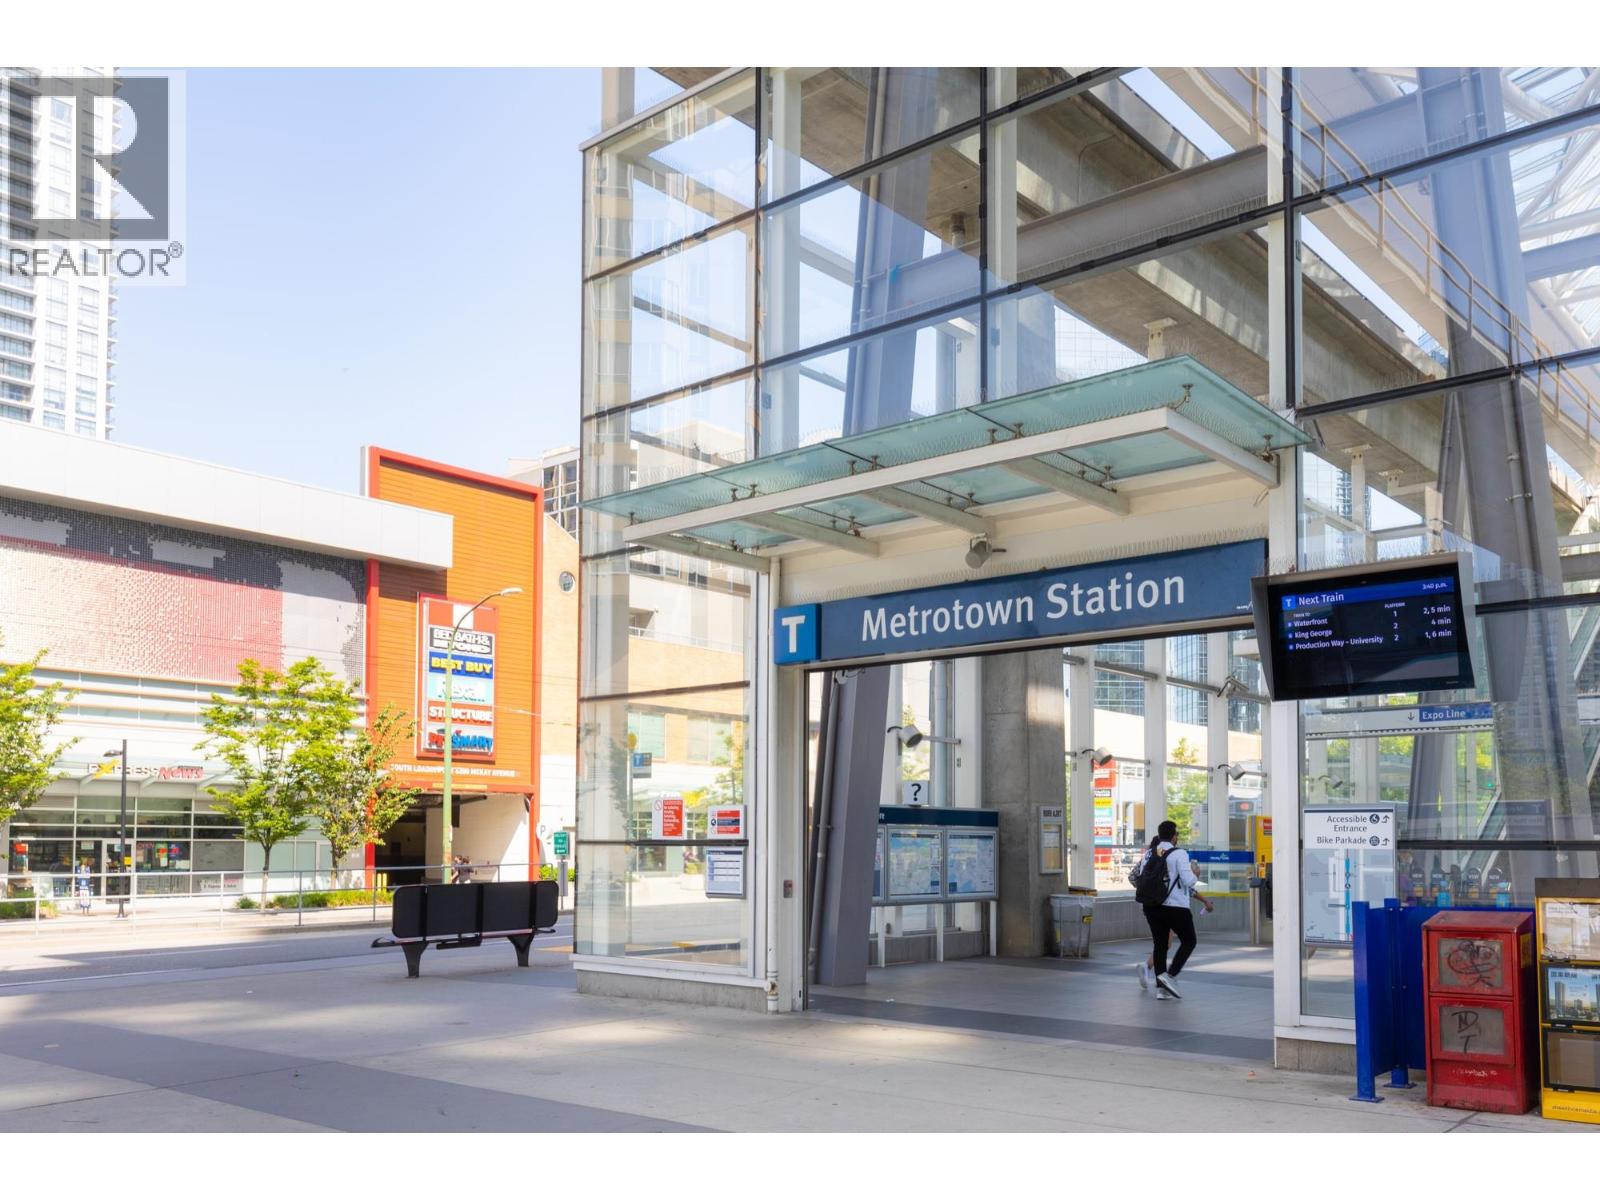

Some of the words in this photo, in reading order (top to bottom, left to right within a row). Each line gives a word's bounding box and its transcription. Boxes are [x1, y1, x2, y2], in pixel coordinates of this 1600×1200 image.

[1299, 596, 1319, 606] Next
[1320, 592, 1345, 603] Train
[862, 594, 1033, 641] Metrotown
[1047, 572, 1185, 619] Station
[1293, 618, 1328, 628] Waterfront
[1423, 607, 1430, 615] 2,
[1436, 604, 1451, 613] min
[781, 615, 806, 653] T
[1295, 631, 1309, 640] King
[1310, 629, 1333, 638] George
[1437, 616, 1452, 625] min
[1295, 640, 1330, 650] Production
[1331, 639, 1345, 648] Way
[1350, 635, 1384, 645] University
[1425, 631, 1431, 639] 1,
[1438, 629, 1452, 637] min
[465, 661, 493, 674] BUY
[1422, 711, 1444, 722] Expo
[1446, 709, 1466, 719] Line
[1326, 814, 1367, 824] Accessible
[1333, 824, 1367, 833] Entrance
[1317, 836, 1333, 845] Bike
[1335, 836, 1367, 845] Parkade
